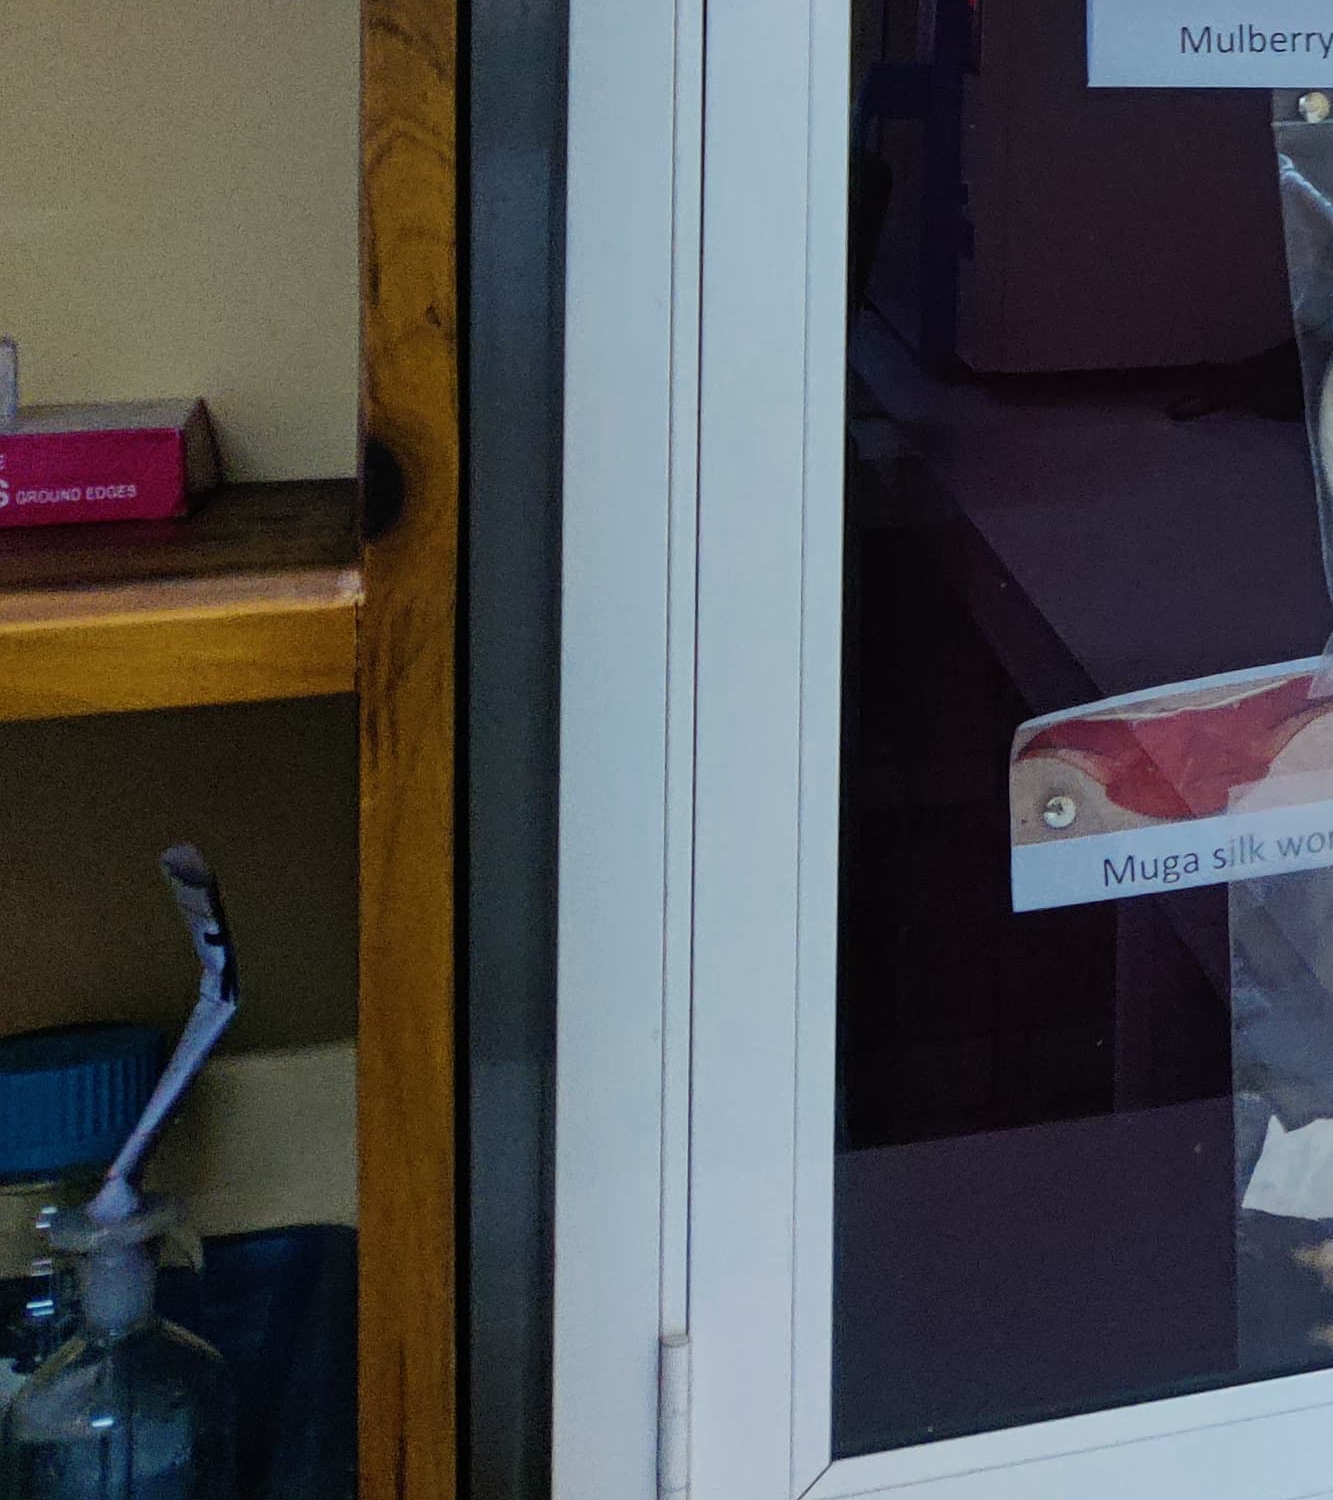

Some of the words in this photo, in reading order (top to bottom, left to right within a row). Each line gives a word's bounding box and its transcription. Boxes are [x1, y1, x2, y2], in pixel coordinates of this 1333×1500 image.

[1180, 24, 1332, 58] Mulberry
[16, 487, 81, 505] GROUND
[86, 485, 137, 500] EDGES
[1103, 849, 1200, 889] Muga
[1212, 836, 1265, 870] silk
